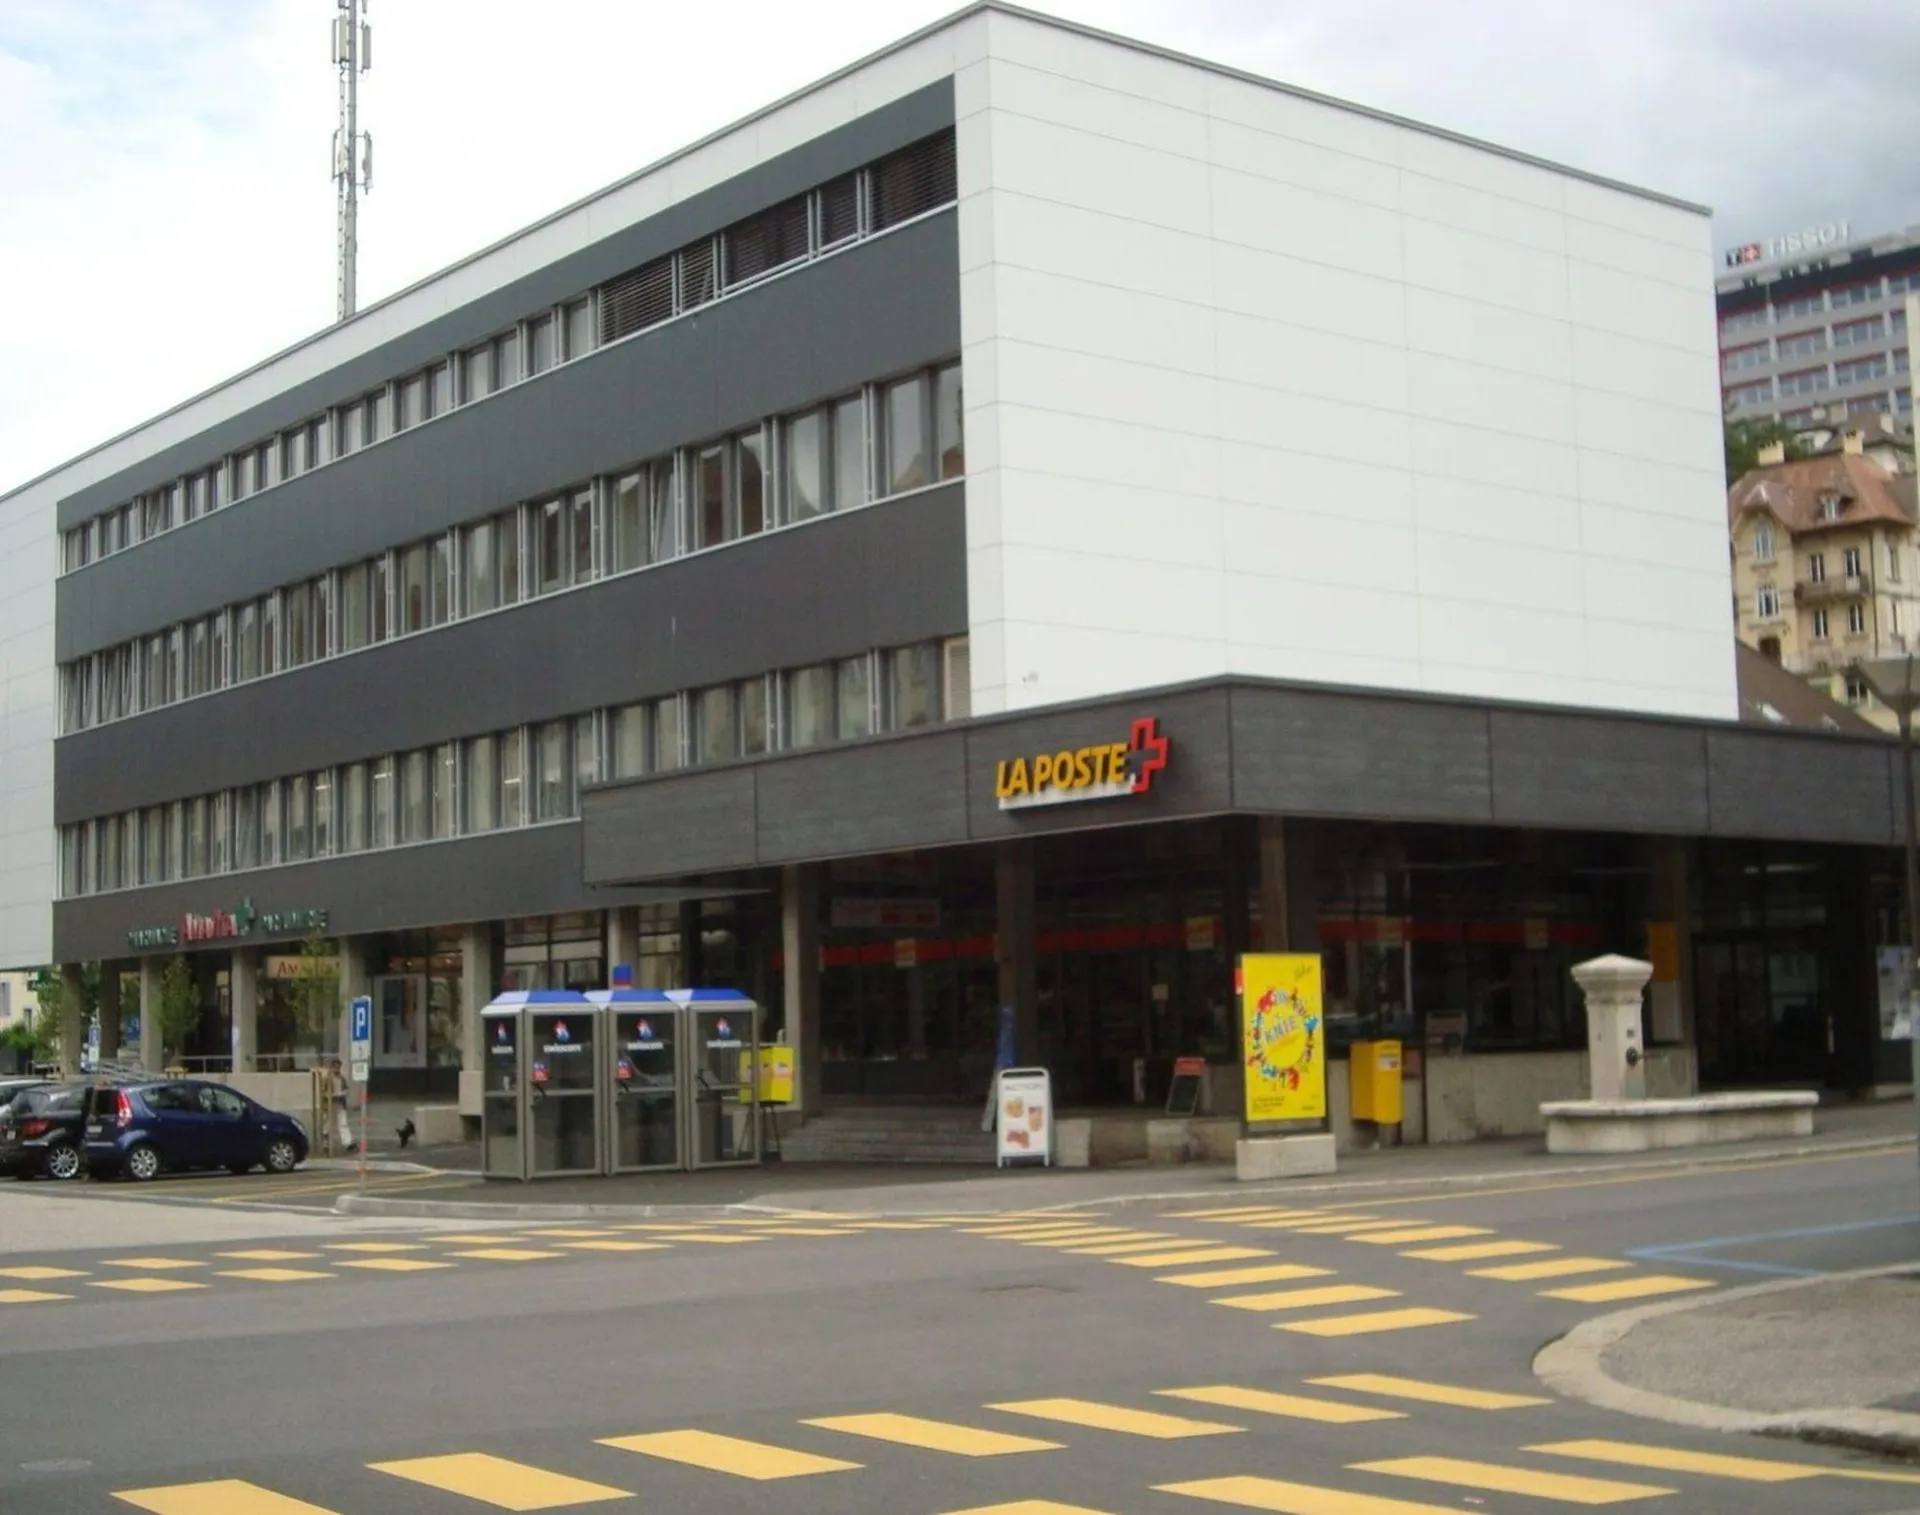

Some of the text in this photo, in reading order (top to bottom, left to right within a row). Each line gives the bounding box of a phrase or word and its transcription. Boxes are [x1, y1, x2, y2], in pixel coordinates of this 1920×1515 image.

[996, 742, 1128, 799] LA POSTE
[356, 1006, 366, 1038] P
